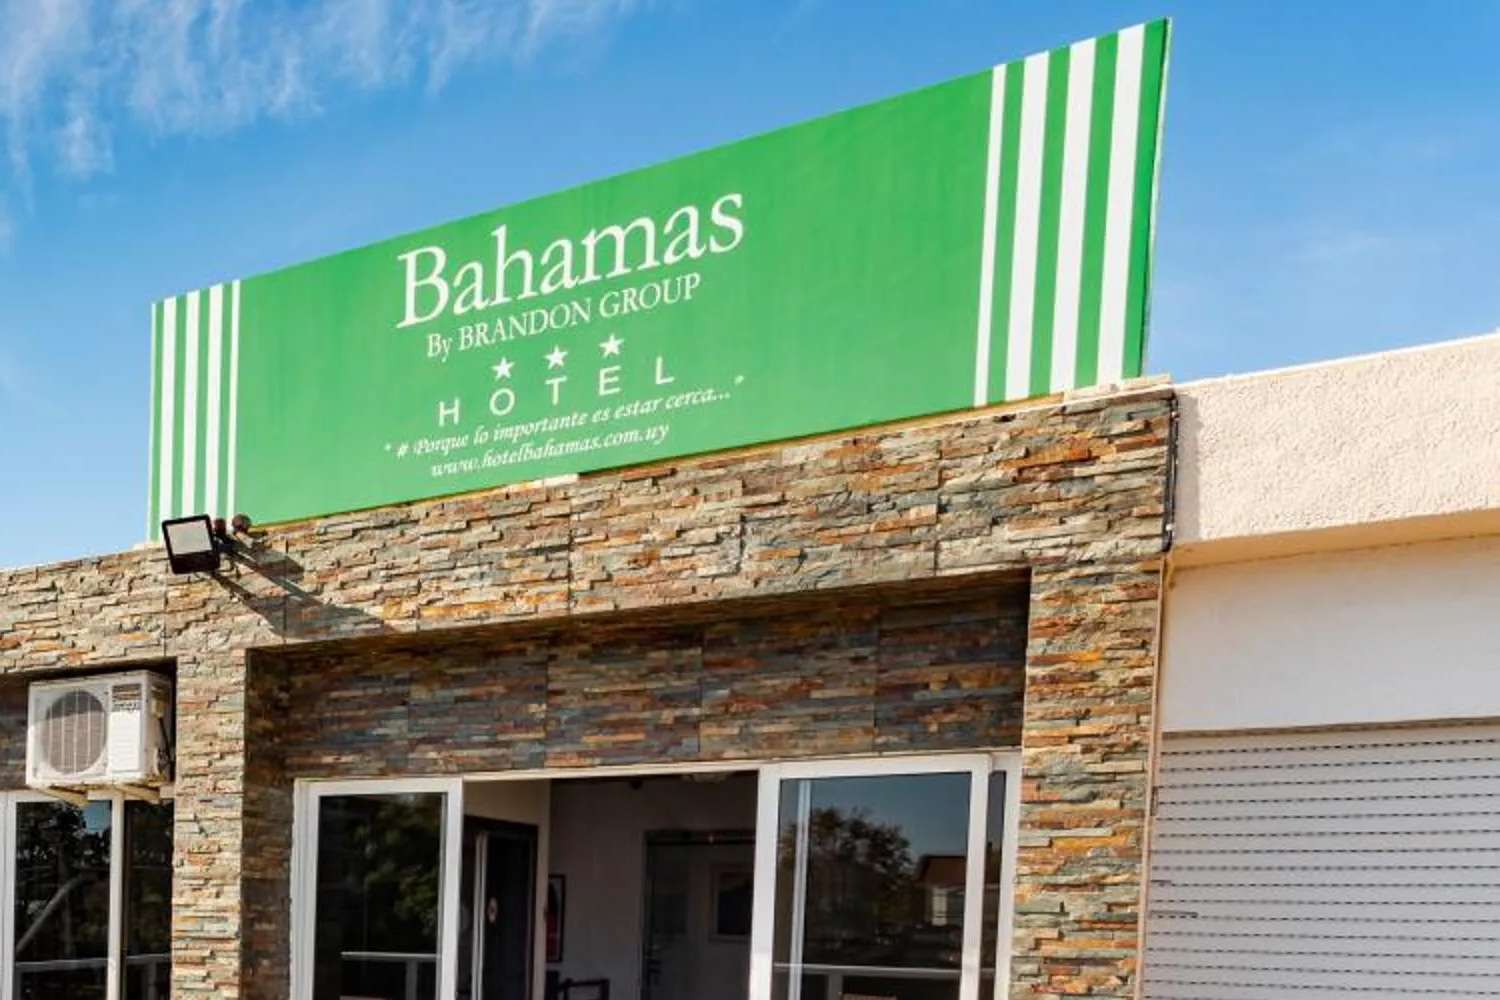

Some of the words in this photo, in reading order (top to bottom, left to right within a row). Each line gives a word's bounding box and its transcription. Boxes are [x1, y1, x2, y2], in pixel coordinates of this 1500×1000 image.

[396, 193, 744, 329] Bahamas
[427, 333, 452, 363] By
[459, 298, 593, 350] BRANDON
[598, 272, 701, 319] GROUP
[413, 433, 469, 456] Porque
[473, 425, 489, 445] lo
[493, 412, 589, 443] importante
[591, 407, 611, 423] es
[613, 398, 664, 420] estar
[437, 355, 675, 428] HOTEL
[431, 423, 669, 477] www.hotelbahamas.com.uy
